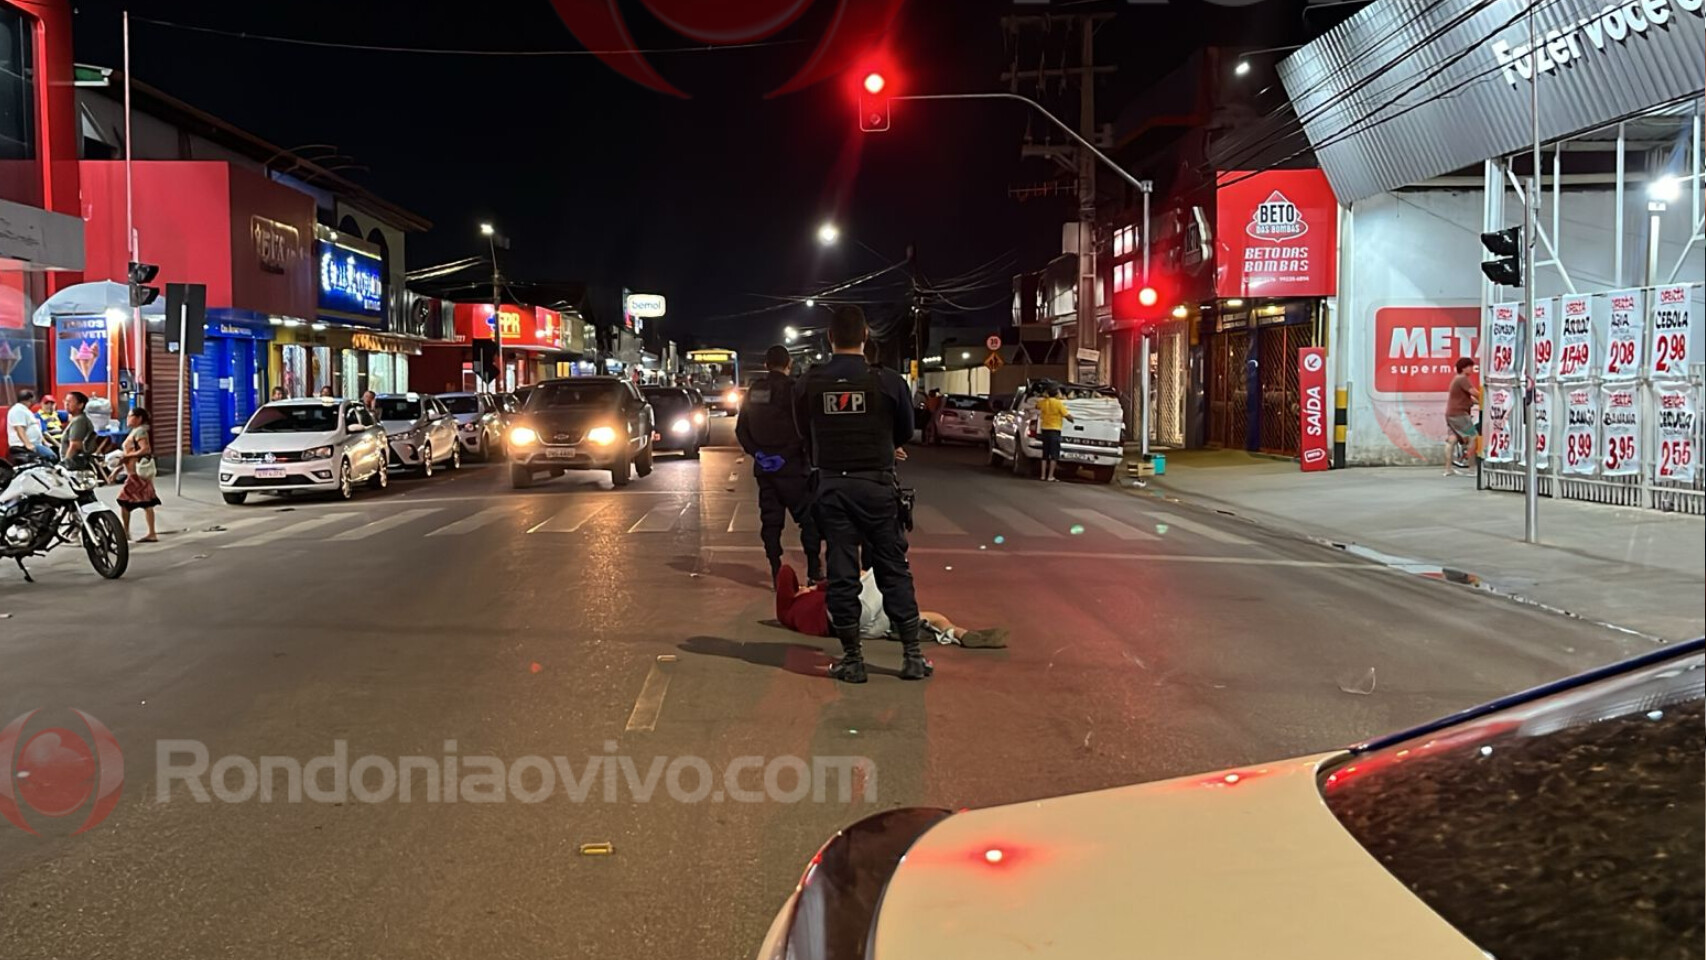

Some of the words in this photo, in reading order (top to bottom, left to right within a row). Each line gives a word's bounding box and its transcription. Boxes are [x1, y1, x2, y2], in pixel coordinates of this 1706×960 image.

[1260, 205, 1295, 223] BETO
[1244, 247, 1281, 259] BETO
[1281, 246, 1308, 259] DAS
[1244, 260, 1308, 272] BOMBAS
[631, 298, 661, 310] bemol
[1655, 311, 1689, 329] CEBOLA
[1388, 327, 1481, 359] MET
[1608, 339, 1635, 374] 2,08
[1655, 333, 1686, 373] 2,98
[1306, 386, 1321, 436] SAÍDA
[1568, 433, 1592, 466] 8,99
[1605, 436, 1635, 470] 3,95
[1659, 440, 1691, 476] 2,55
